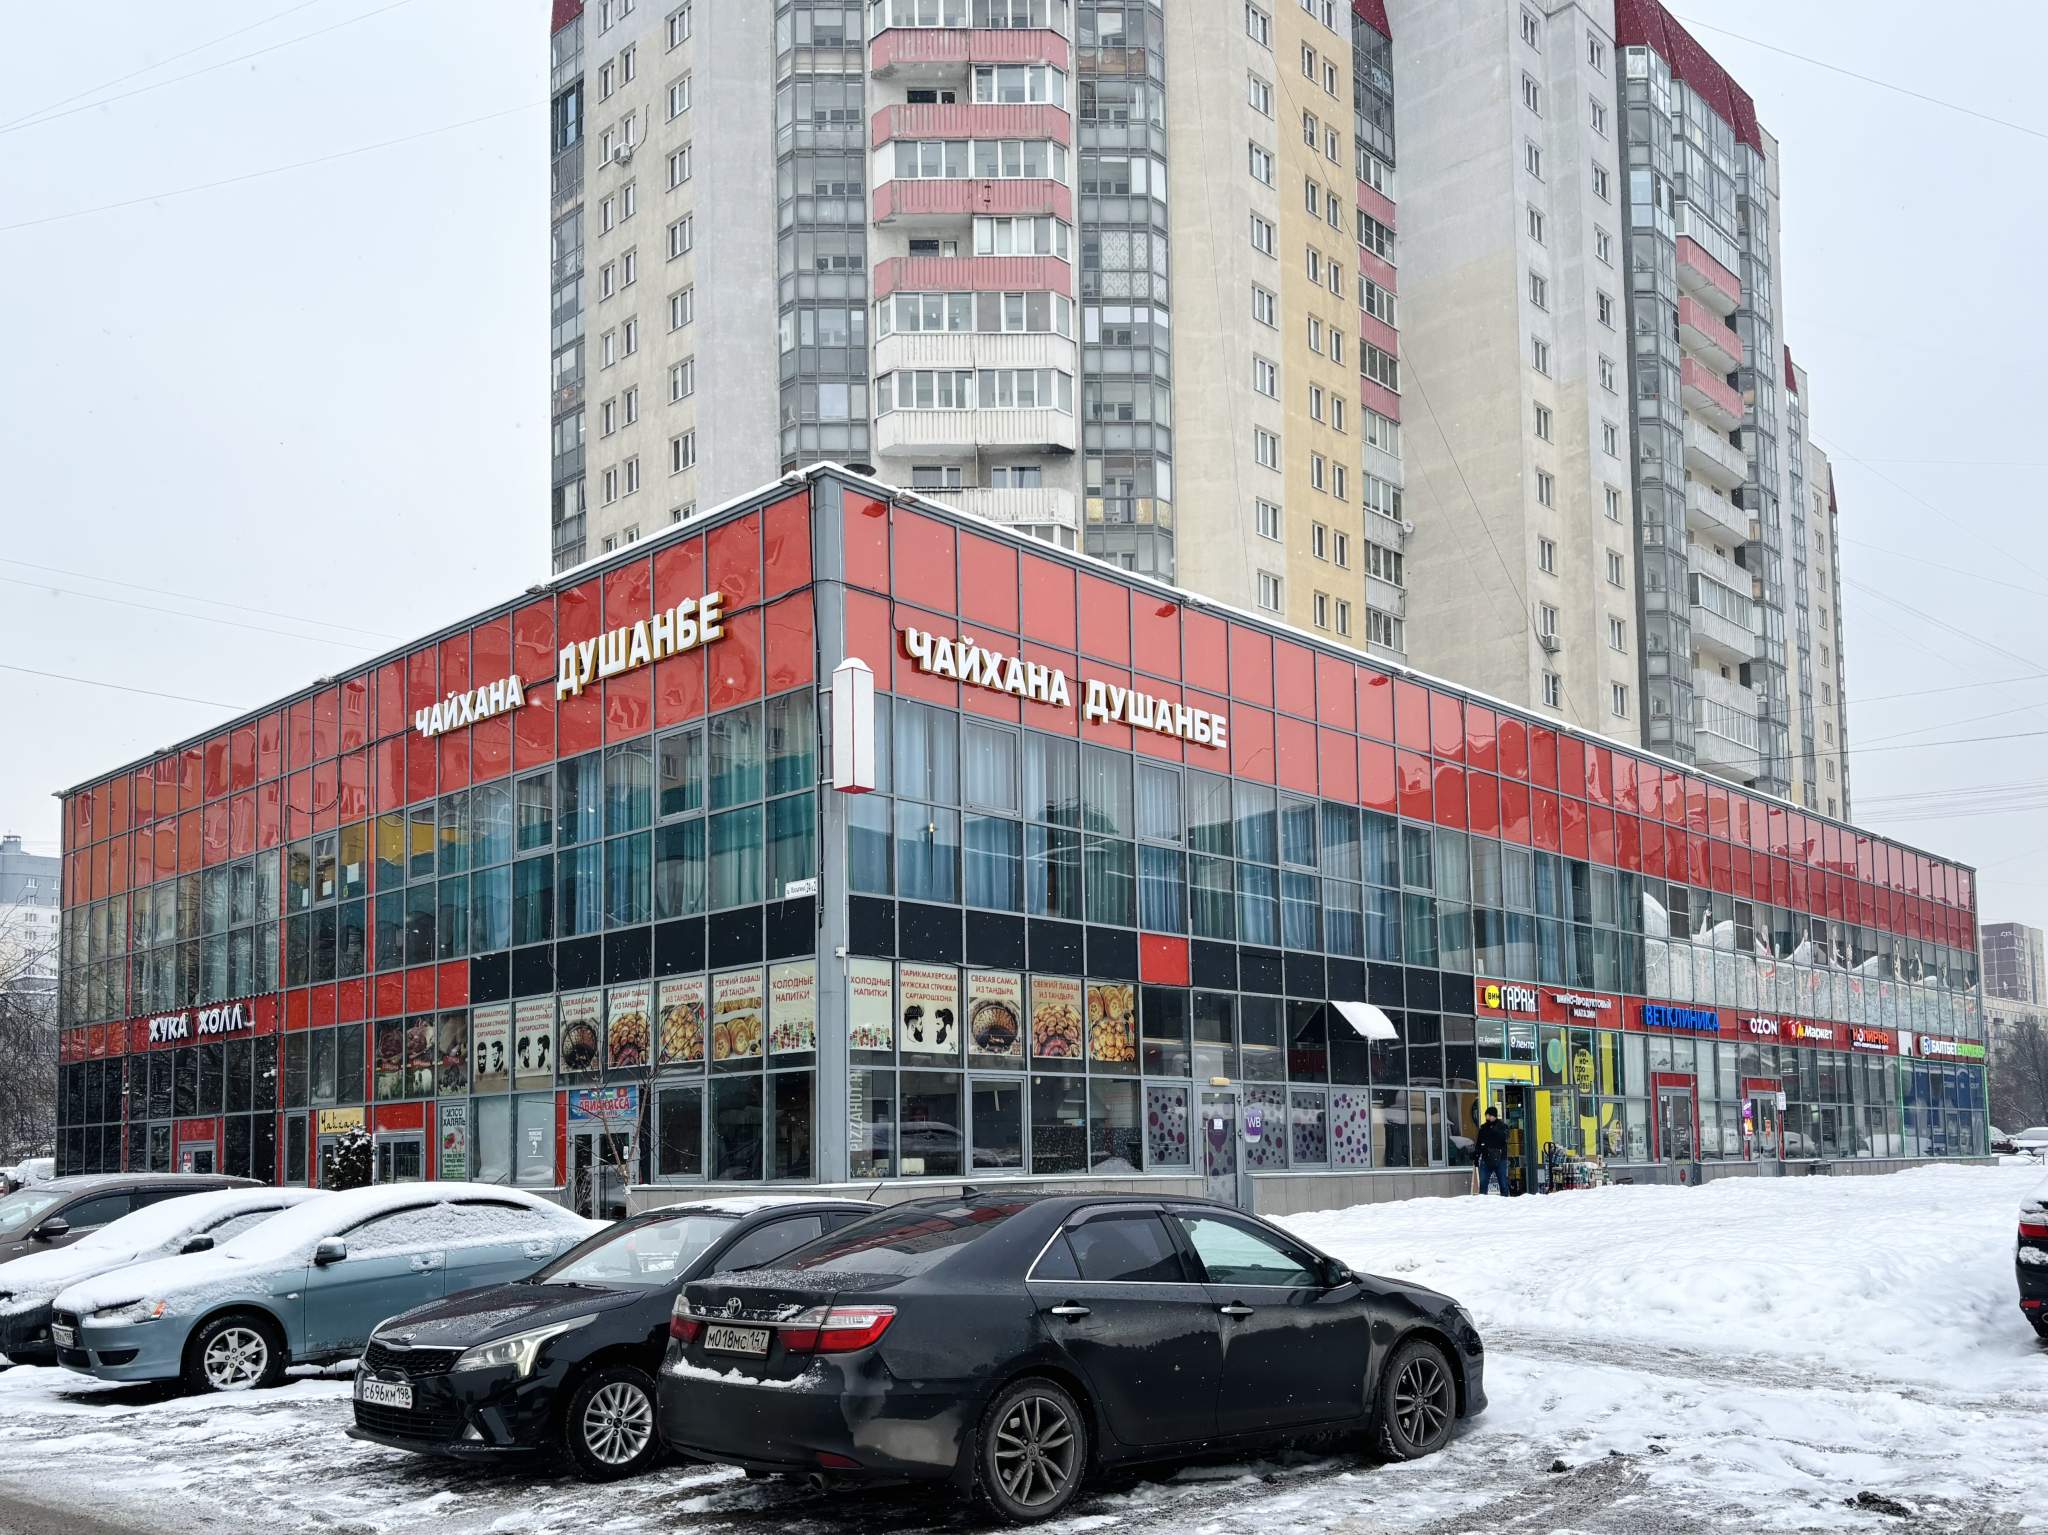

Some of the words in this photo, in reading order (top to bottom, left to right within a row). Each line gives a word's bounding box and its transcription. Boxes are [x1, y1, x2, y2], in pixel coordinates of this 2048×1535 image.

[415, 674, 525, 737] ЧАЙХАНА
[556, 591, 724, 701] ДУШАНБЕ
[905, 627, 1071, 707] ЧАЙХАНА
[1082, 679, 1227, 748] ДУШАНБЕ
[715, 977, 739, 988] СВЕЖИЙ
[739, 974, 761, 985] ЛАВАШ
[850, 976, 891, 987] ХОЛОДНЫЕ
[901, 969, 957, 981] ПАРИКМАХЕРСКАЯ
[971, 974, 995, 983] СВЕЖАЯ
[996, 977, 1018, 985] САМСА
[662, 983, 683, 994] СВЕЖАЯ
[684, 981, 703, 991] САМСА
[772, 975, 814, 990] ХОЛОДНЫЕ
[901, 981, 930, 990] МУЖСКАЯ
[930, 983, 957, 992] СТРИЖКА
[1033, 980, 1057, 990] СВЕЖИЙ
[1057, 982, 1080, 991] ЛАВАШ
[719, 989, 729, 998] ИЗ
[730, 986, 755, 996] ТАНДЫРА
[775, 990, 810, 1003] НАПИТКИ
[853, 988, 888, 998] НАПИТКИ
[976, 986, 985, 994] ИЗ
[986, 987, 1014, 996] ТАНДЫРА
[1039, 992, 1047, 1000] ИЗ
[614, 1001, 622, 1010] ИЗ
[1501, 985, 1536, 1013] ГАРАЖ
[149, 1012, 191, 1042] ХУКА
[198, 1003, 244, 1034] ХОЛЛ
[1644, 1004, 1719, 1032] ВЕТКЛИНИКА
[1750, 1017, 1778, 1035] OZON
[1804, 1024, 1833, 1041] Маркет
[1515, 1040, 1535, 1050] лента
[1247, 1116, 1262, 1128] WB
[750, 1331, 766, 1345] 147
[396, 1387, 410, 1400] 198
